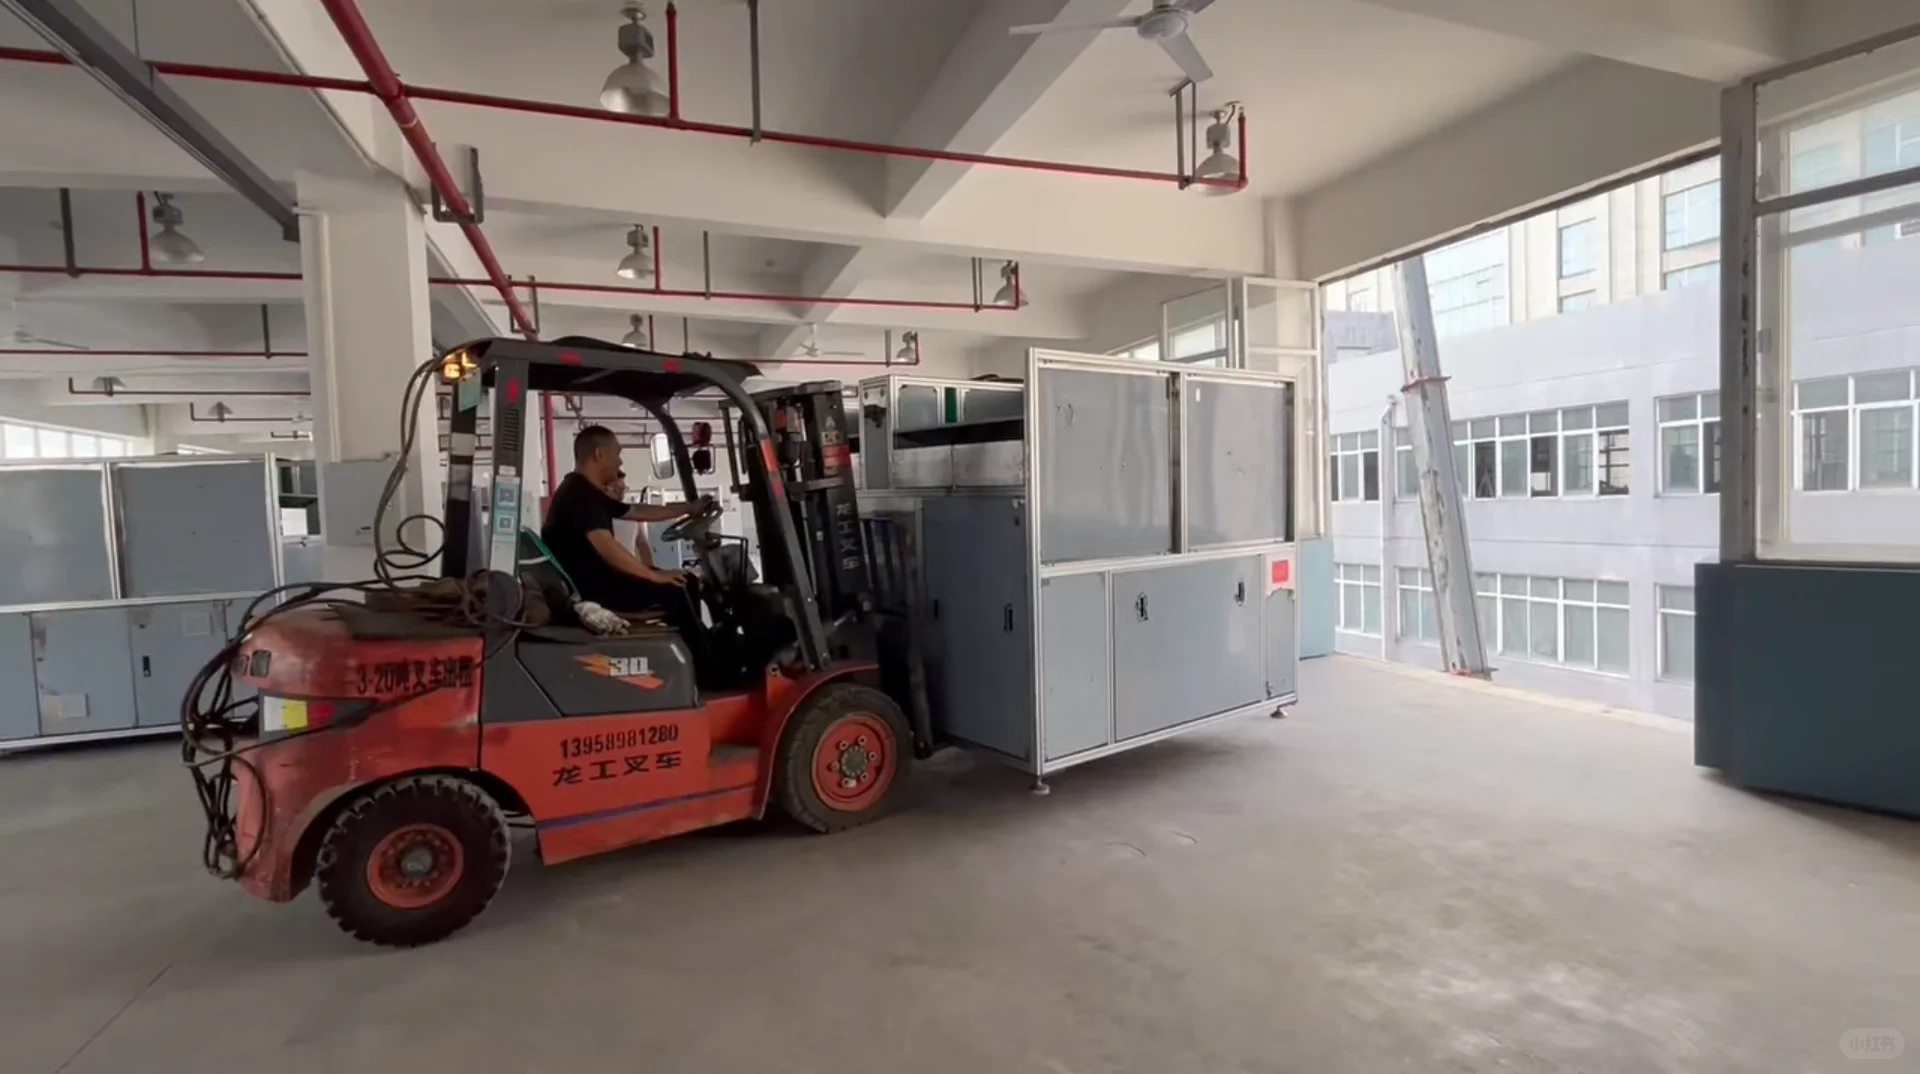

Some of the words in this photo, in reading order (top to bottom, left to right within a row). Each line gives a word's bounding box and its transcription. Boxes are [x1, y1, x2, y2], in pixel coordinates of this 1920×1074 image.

[609, 656, 649, 676] 30
[560, 724, 679, 758] 13958981280
[552, 750, 682, 787] 龙工叉车
